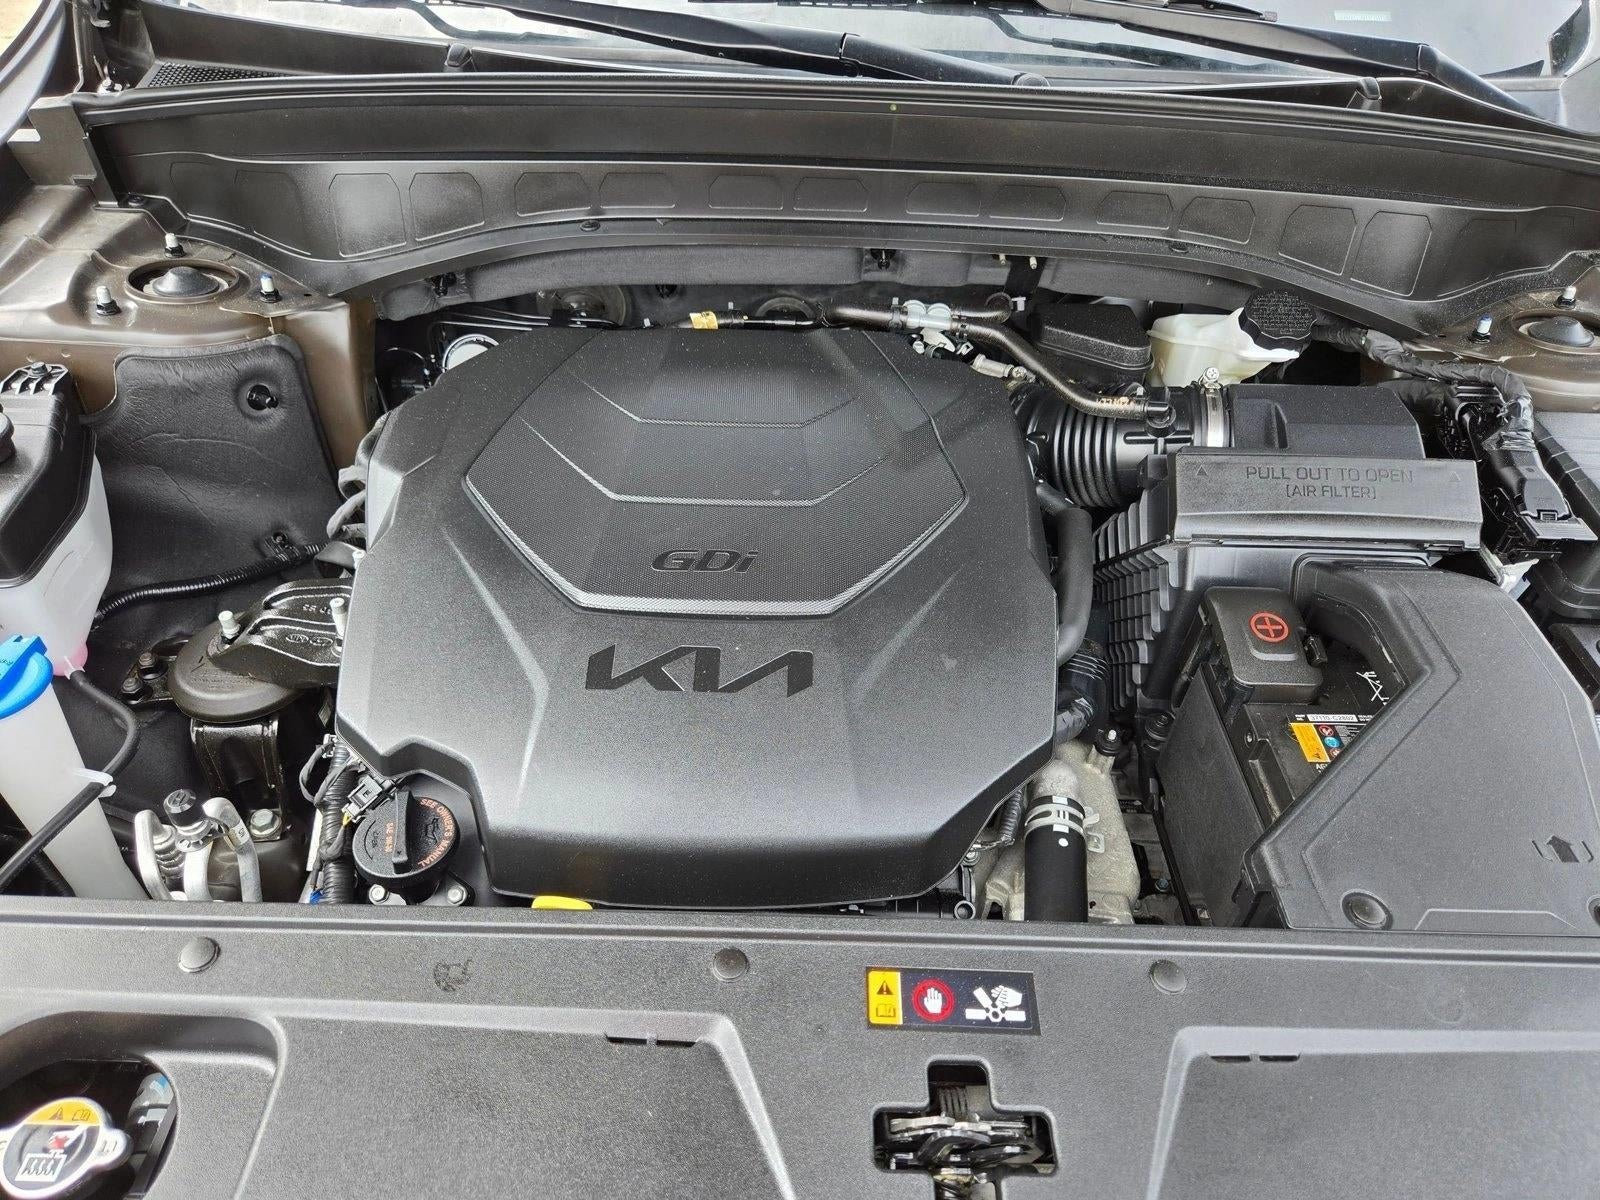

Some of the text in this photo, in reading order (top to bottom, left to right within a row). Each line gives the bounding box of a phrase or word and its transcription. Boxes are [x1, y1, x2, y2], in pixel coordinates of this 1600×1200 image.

[1246, 466, 1414, 483] PULL OUT TO OPEN
[650, 549, 759, 573] GDi
[585, 643, 814, 698] KIA
[420, 798, 438, 809] SEE
[418, 839, 451, 867] MANUAL
